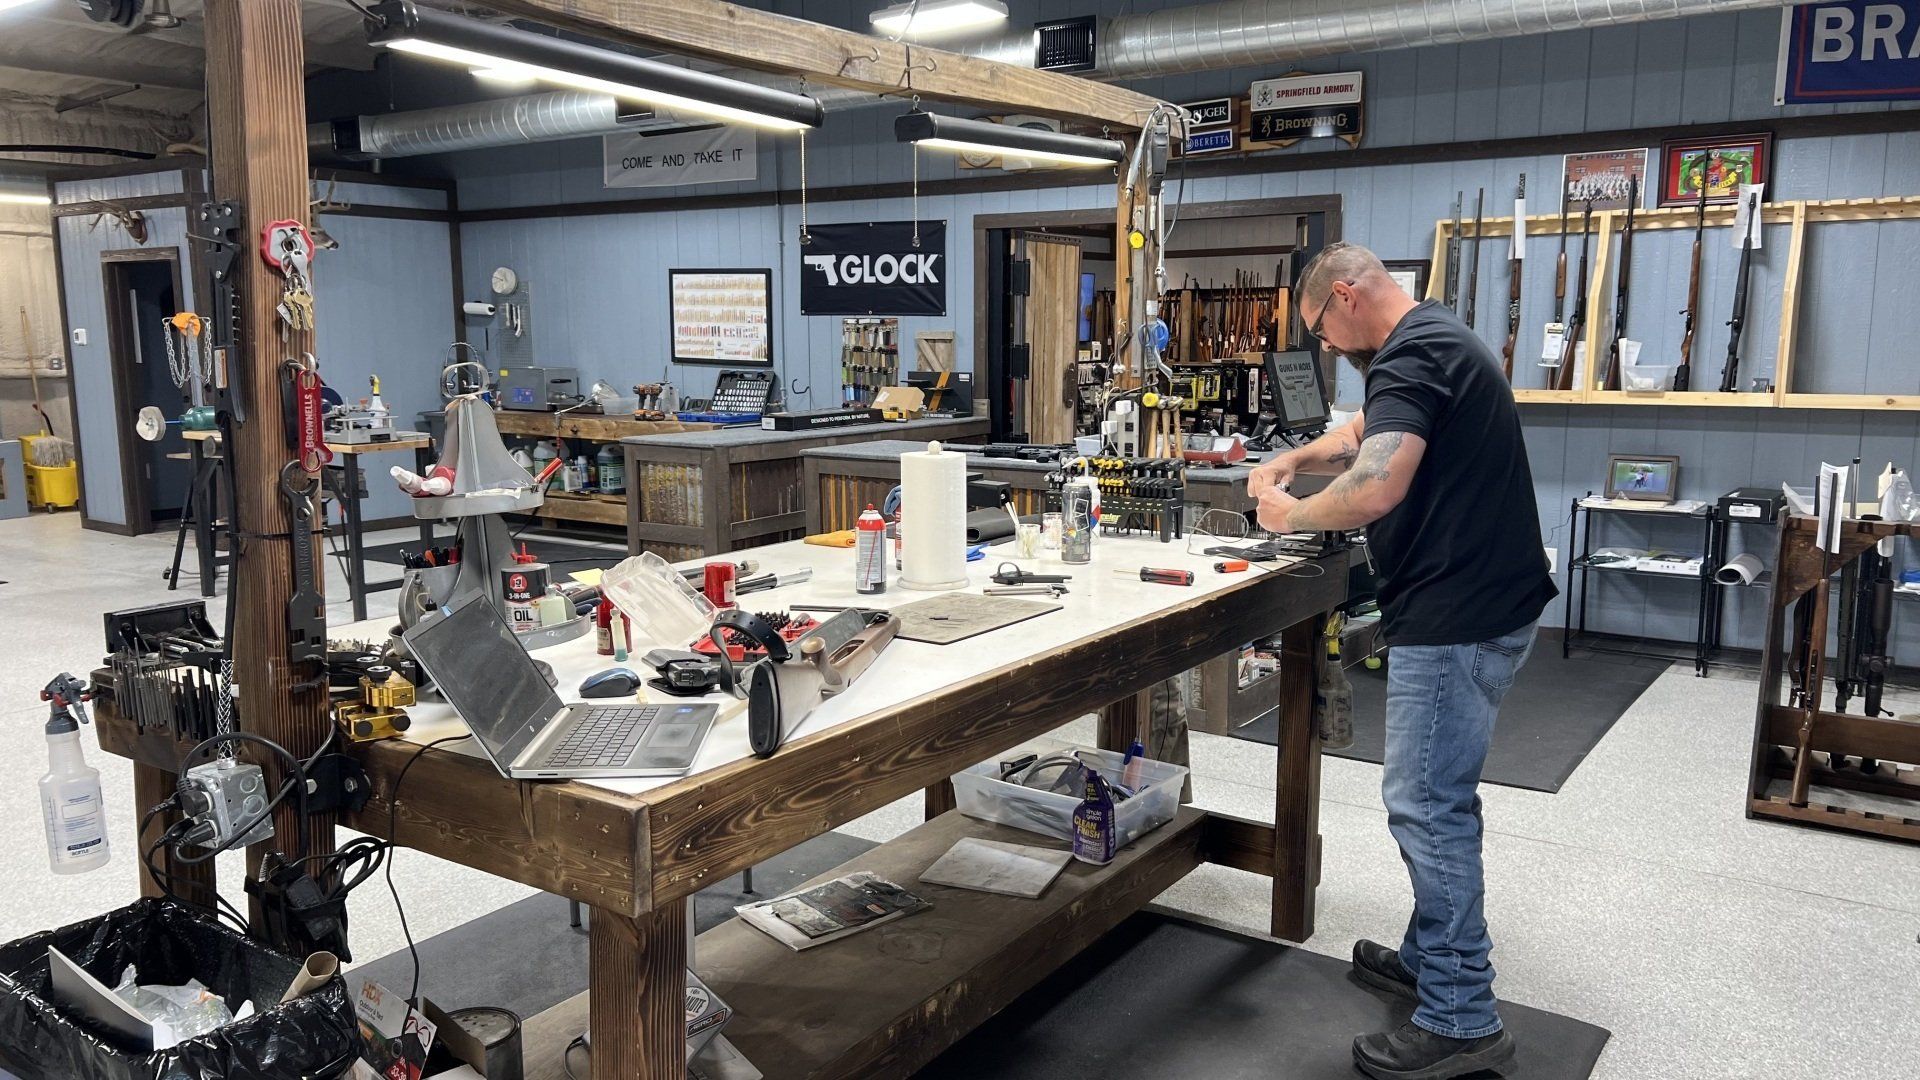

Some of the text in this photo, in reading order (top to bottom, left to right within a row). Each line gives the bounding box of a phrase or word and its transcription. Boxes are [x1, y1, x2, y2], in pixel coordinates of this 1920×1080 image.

[1811, 4, 1920, 62] BR
[1276, 84, 1354, 99] SPRINGFIELD ARMORY
[1275, 113, 1348, 132] BROWNING
[1194, 135, 1230, 148] BERETTA
[622, 148, 743, 170] COME AND TAKE IT
[840, 253, 939, 284] GLOCK
[1279, 363, 1293, 373] GUNS
[1298, 362, 1312, 371] MORE
[304, 393, 315, 449] BROWNELLS
[509, 592, 531, 600] 3-IN-ONE
[514, 610, 533, 622] OIL
[1074, 815, 1097, 830] CLEAN
[1077, 826, 1101, 839] FINISH
[361, 981, 384, 1006] HDX
